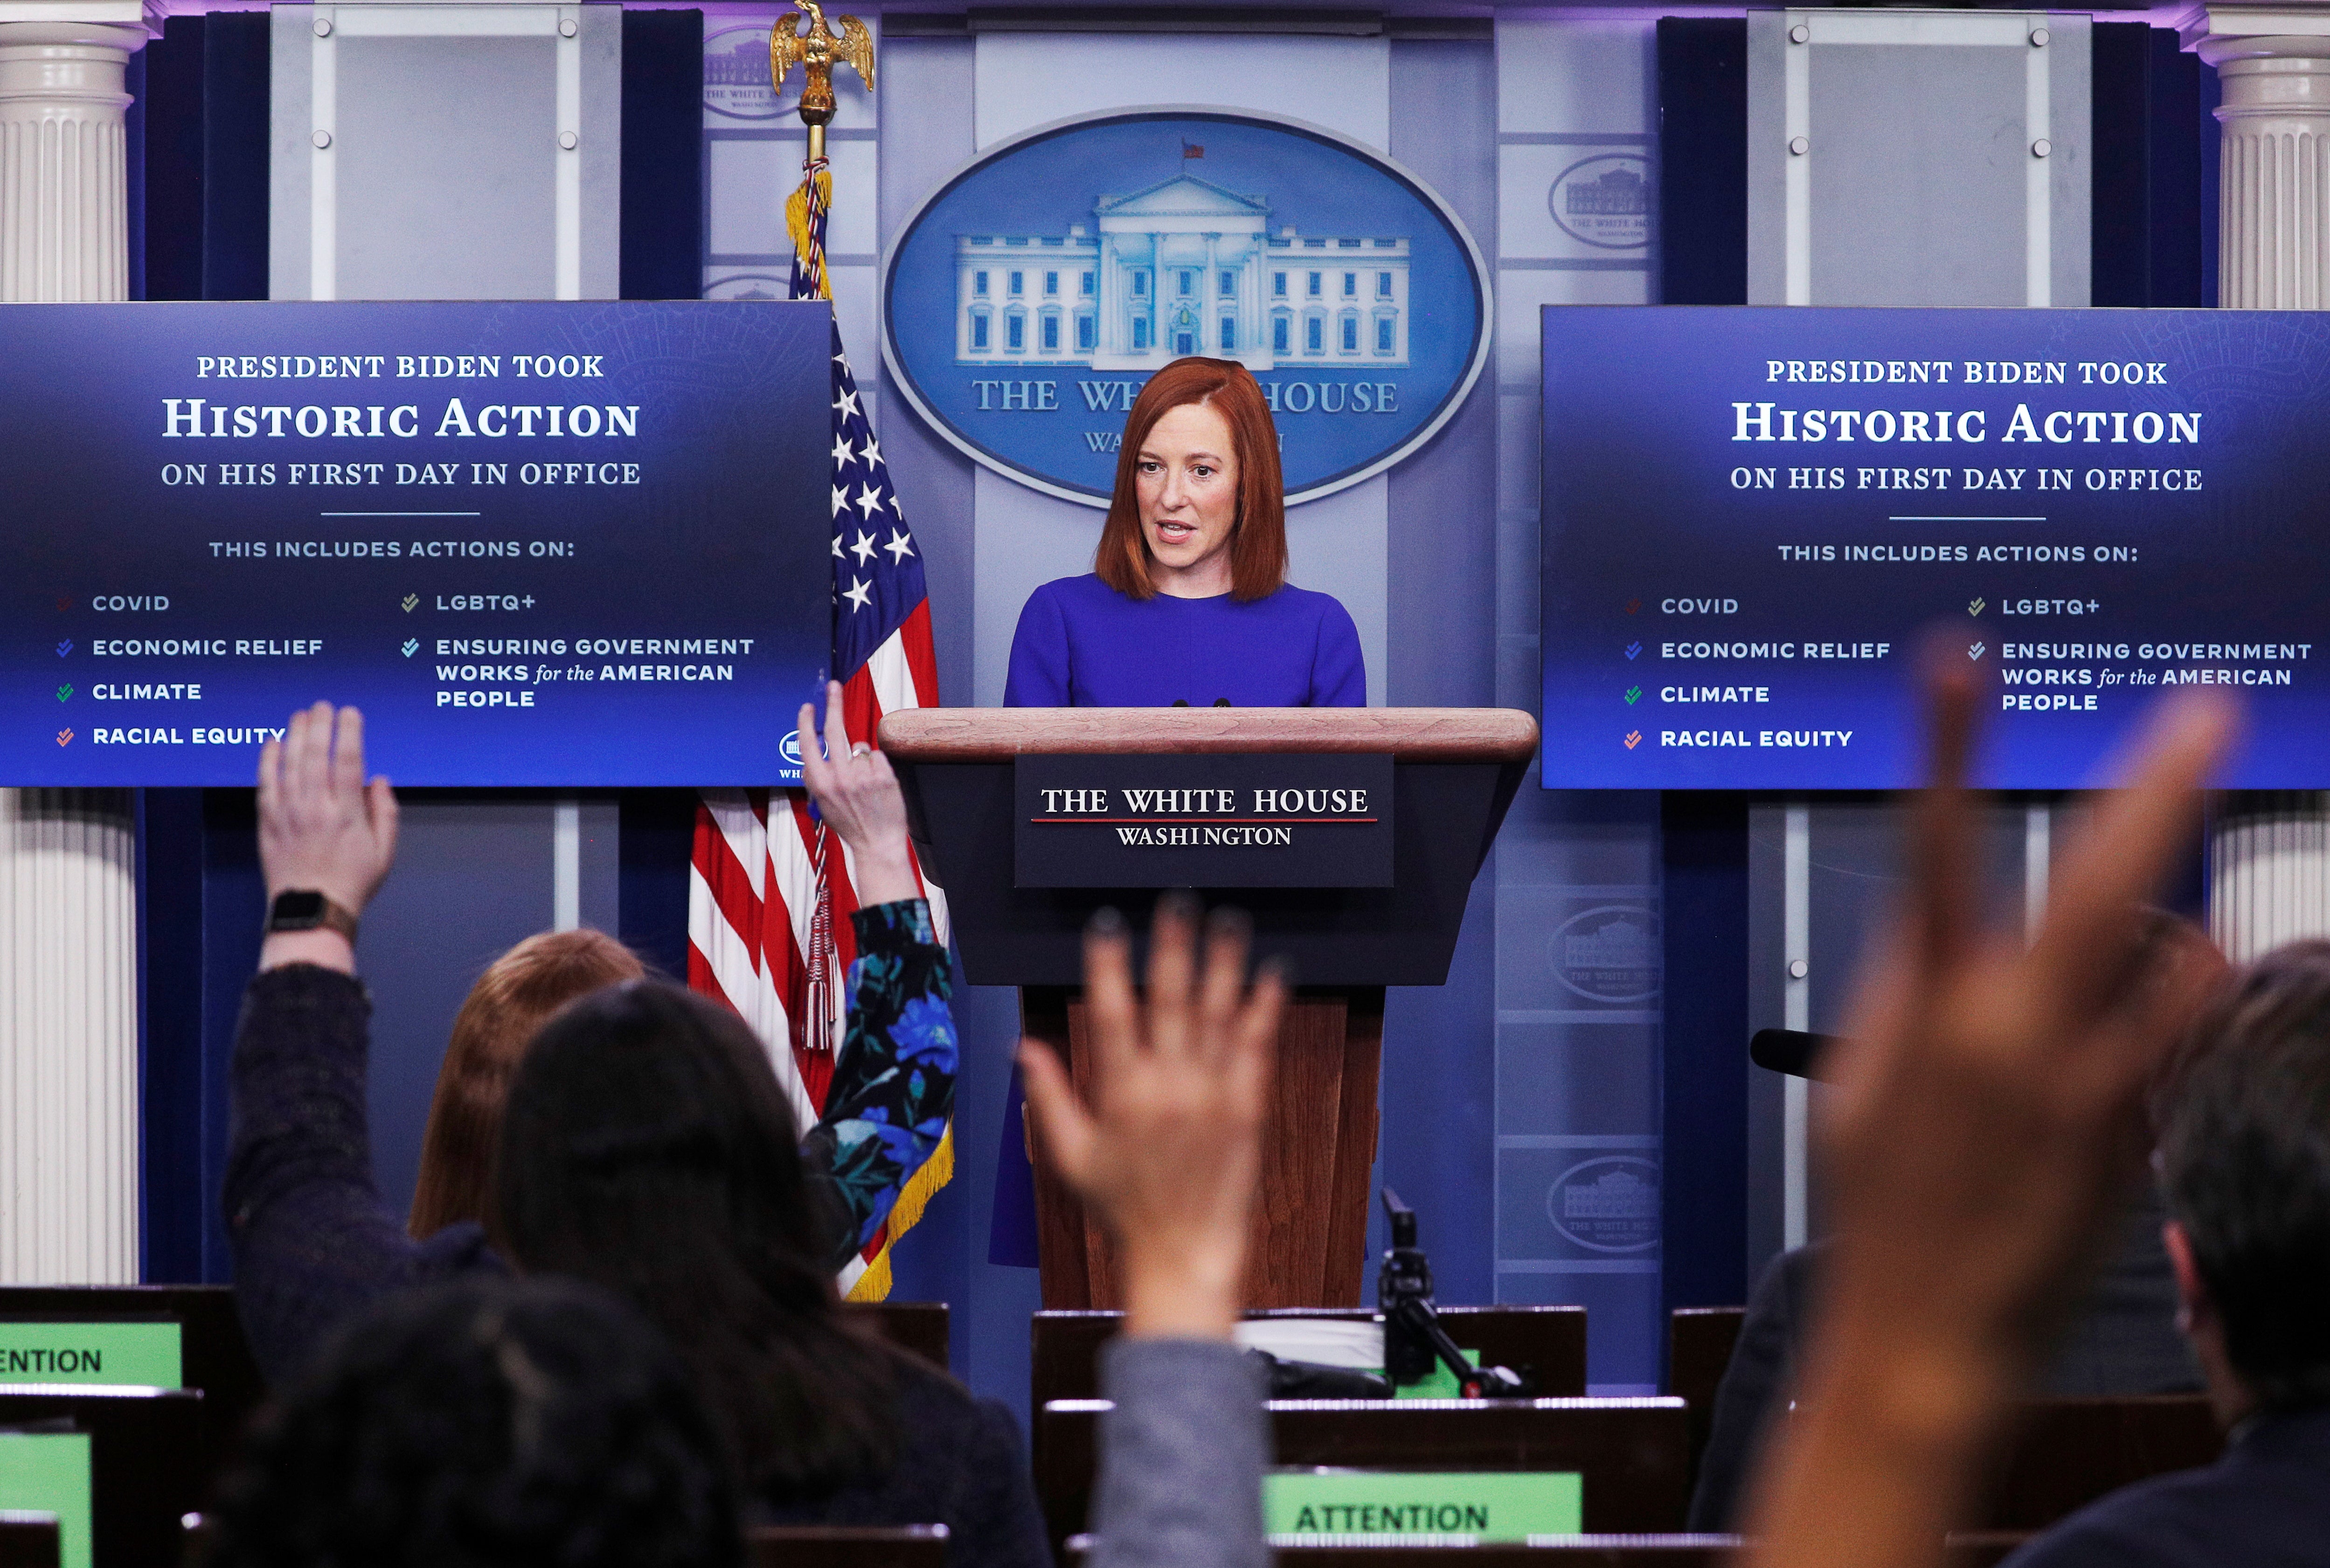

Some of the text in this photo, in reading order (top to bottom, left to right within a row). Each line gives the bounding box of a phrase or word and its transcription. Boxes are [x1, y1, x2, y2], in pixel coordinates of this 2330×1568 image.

[197, 355, 604, 378] PRESIDENT BIDEN TOOK
[1767, 361, 1953, 383] PRESIDENT
[1964, 361, 2067, 384] BIDEN
[2078, 362, 2167, 384] TOOK
[971, 379, 1060, 411] THE
[162, 397, 640, 438] HISTORIC ACTION
[1731, 402, 2202, 443] HISTORIC ACTION
[161, 463, 640, 486] ON HIS FIRST DAY IN OFFICE
[1731, 467, 2203, 491] ON HIS FIRST DAY IN OFFICE
[209, 541, 574, 558] THIS INCLUDES ACTIONS ON:
[1778, 545, 2138, 562] THIS INCLUDES ACTIONS ON:
[92, 595, 170, 611] COVID
[437, 594, 535, 611] LGBTQ+
[1661, 598, 1739, 614] COVID
[2003, 598, 2100, 615] LGBTQ+
[93, 639, 323, 656] ECONOMIC RELIEF
[437, 639, 754, 655] ENSURING GOVERNMENT
[1662, 642, 1890, 659] ECONOMIC RELIEF
[2003, 643, 2312, 659] ENSURING GOVERNMENT
[436, 664, 733, 685] WORKS for the AMERICAN
[2002, 668, 2291, 689] WORKS for the AMERICAN
[92, 684, 202, 700] CLIMATE
[437, 691, 535, 707] PEOPLE
[1661, 687, 1770, 703] CLIMATE
[2003, 694, 2098, 711] PEOPLE
[94, 728, 286, 745] RACIAL EQUITY
[1661, 730, 1853, 747] RACIAL EQUITY
[1041, 789, 1368, 813] THE WHITE HOUSE
[1116, 827, 1292, 846] WASHINGTON
[1294, 1503, 1489, 1533] ATTENTION
